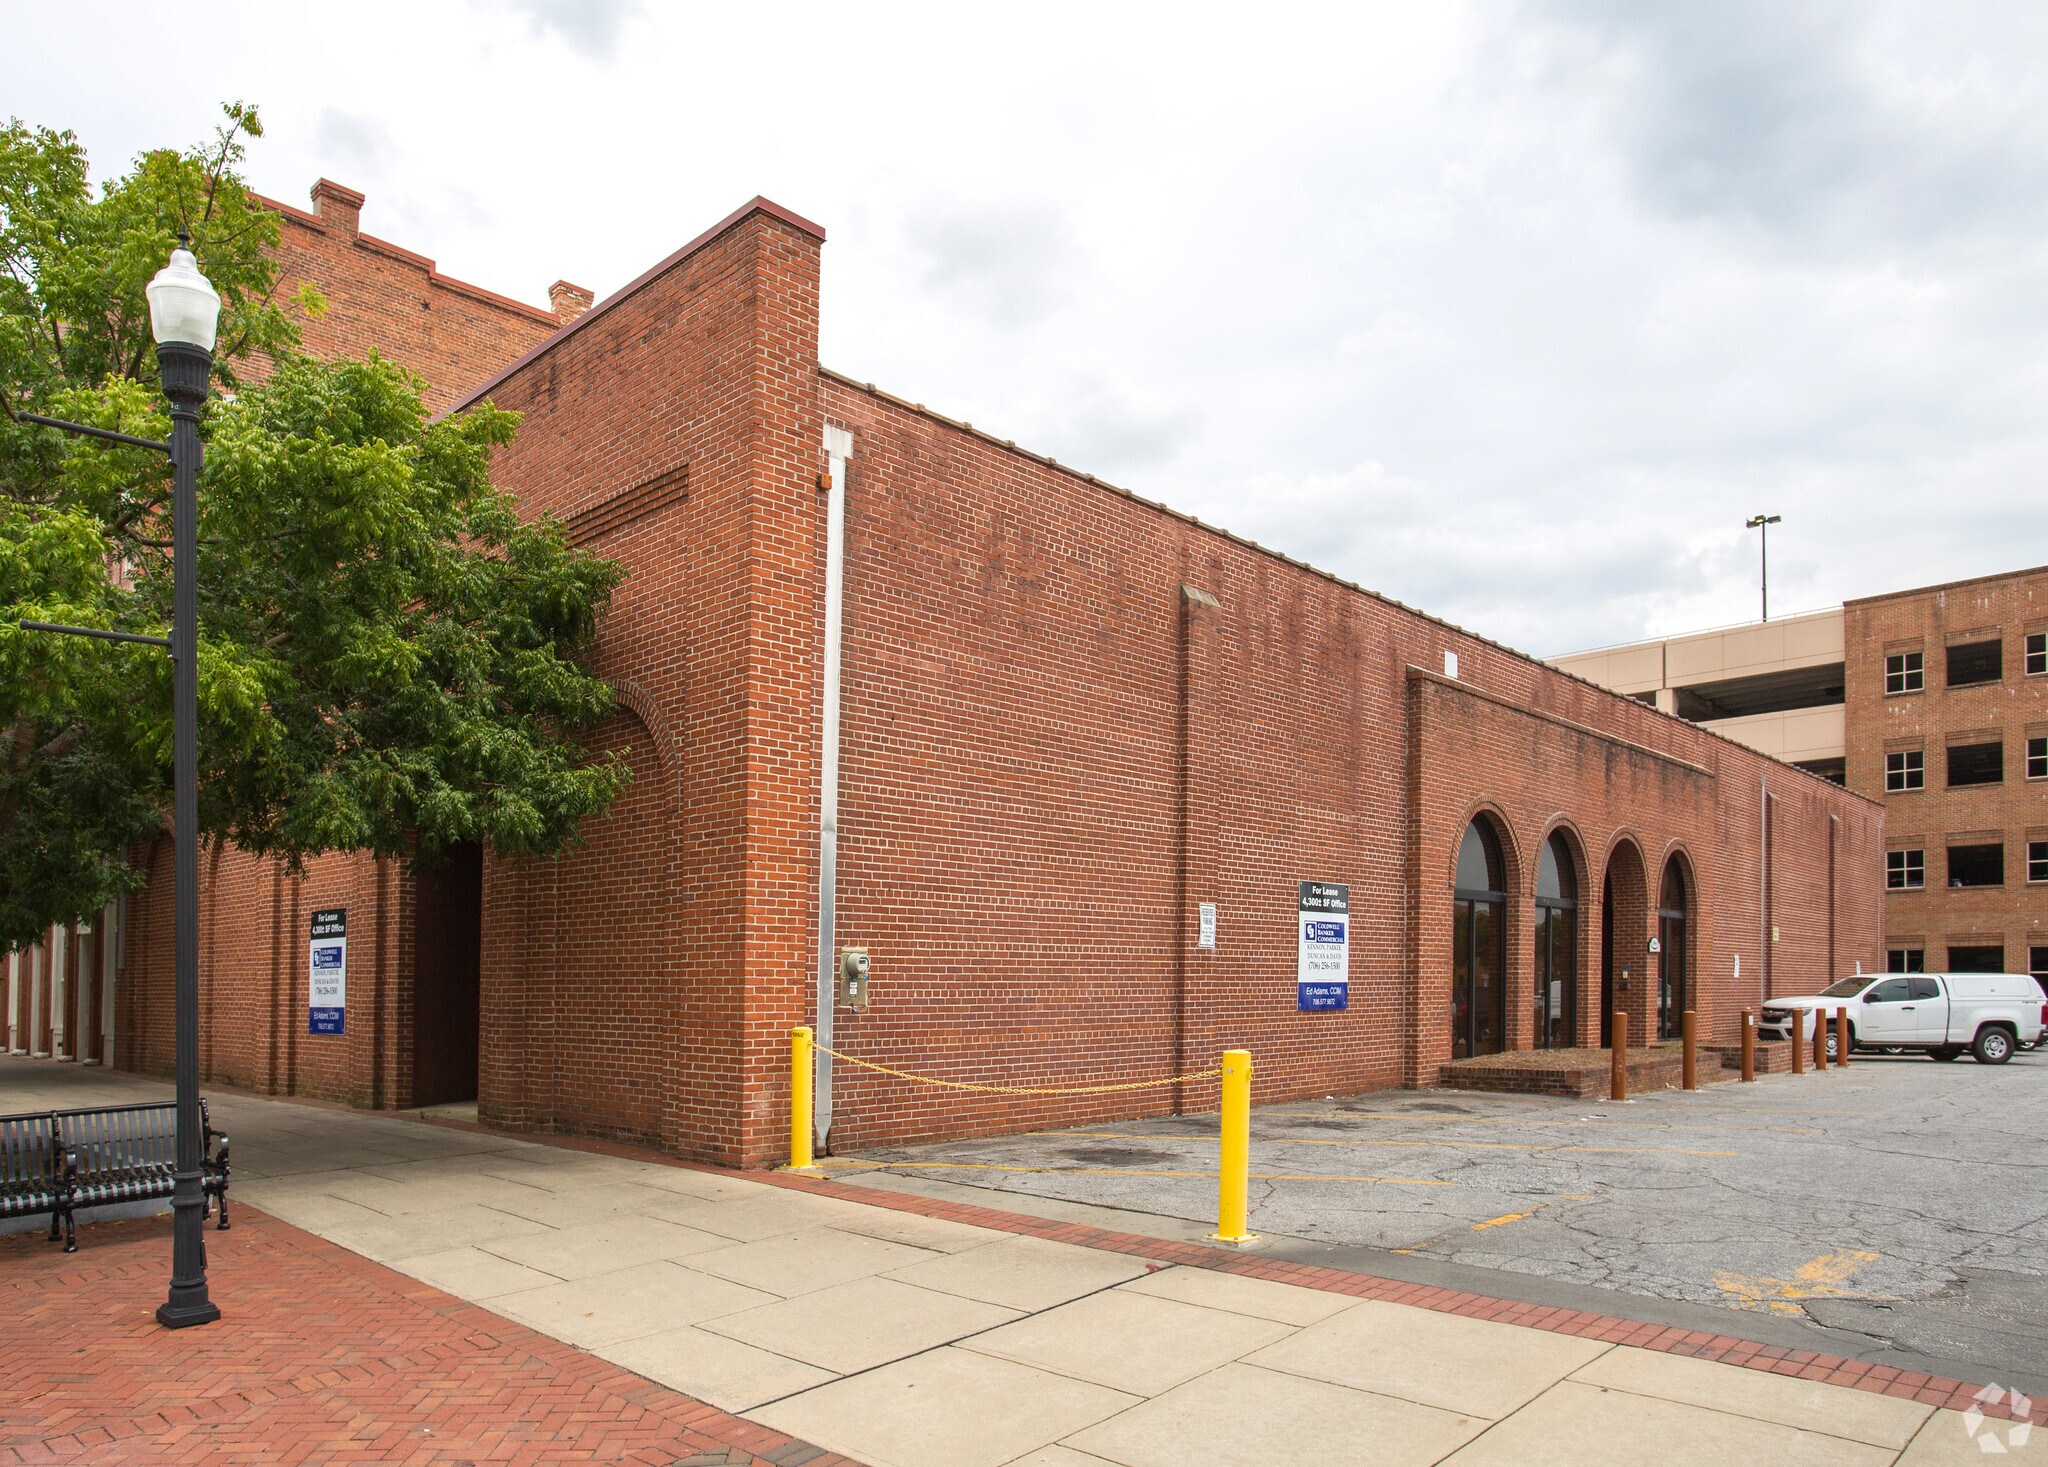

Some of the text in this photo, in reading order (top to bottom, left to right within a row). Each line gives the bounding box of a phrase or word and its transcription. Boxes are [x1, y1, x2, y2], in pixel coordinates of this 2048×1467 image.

[1312, 885, 1338, 897] For Lease
[1322, 899, 1330, 907] SF
[1331, 899, 1346, 909] Office
[325, 913, 338, 922] Lease
[325, 924, 331, 933] SF
[331, 923, 344, 933] Office
[1321, 961, 1341, 970] 256-1500
[1306, 987, 1313, 995] Ed
